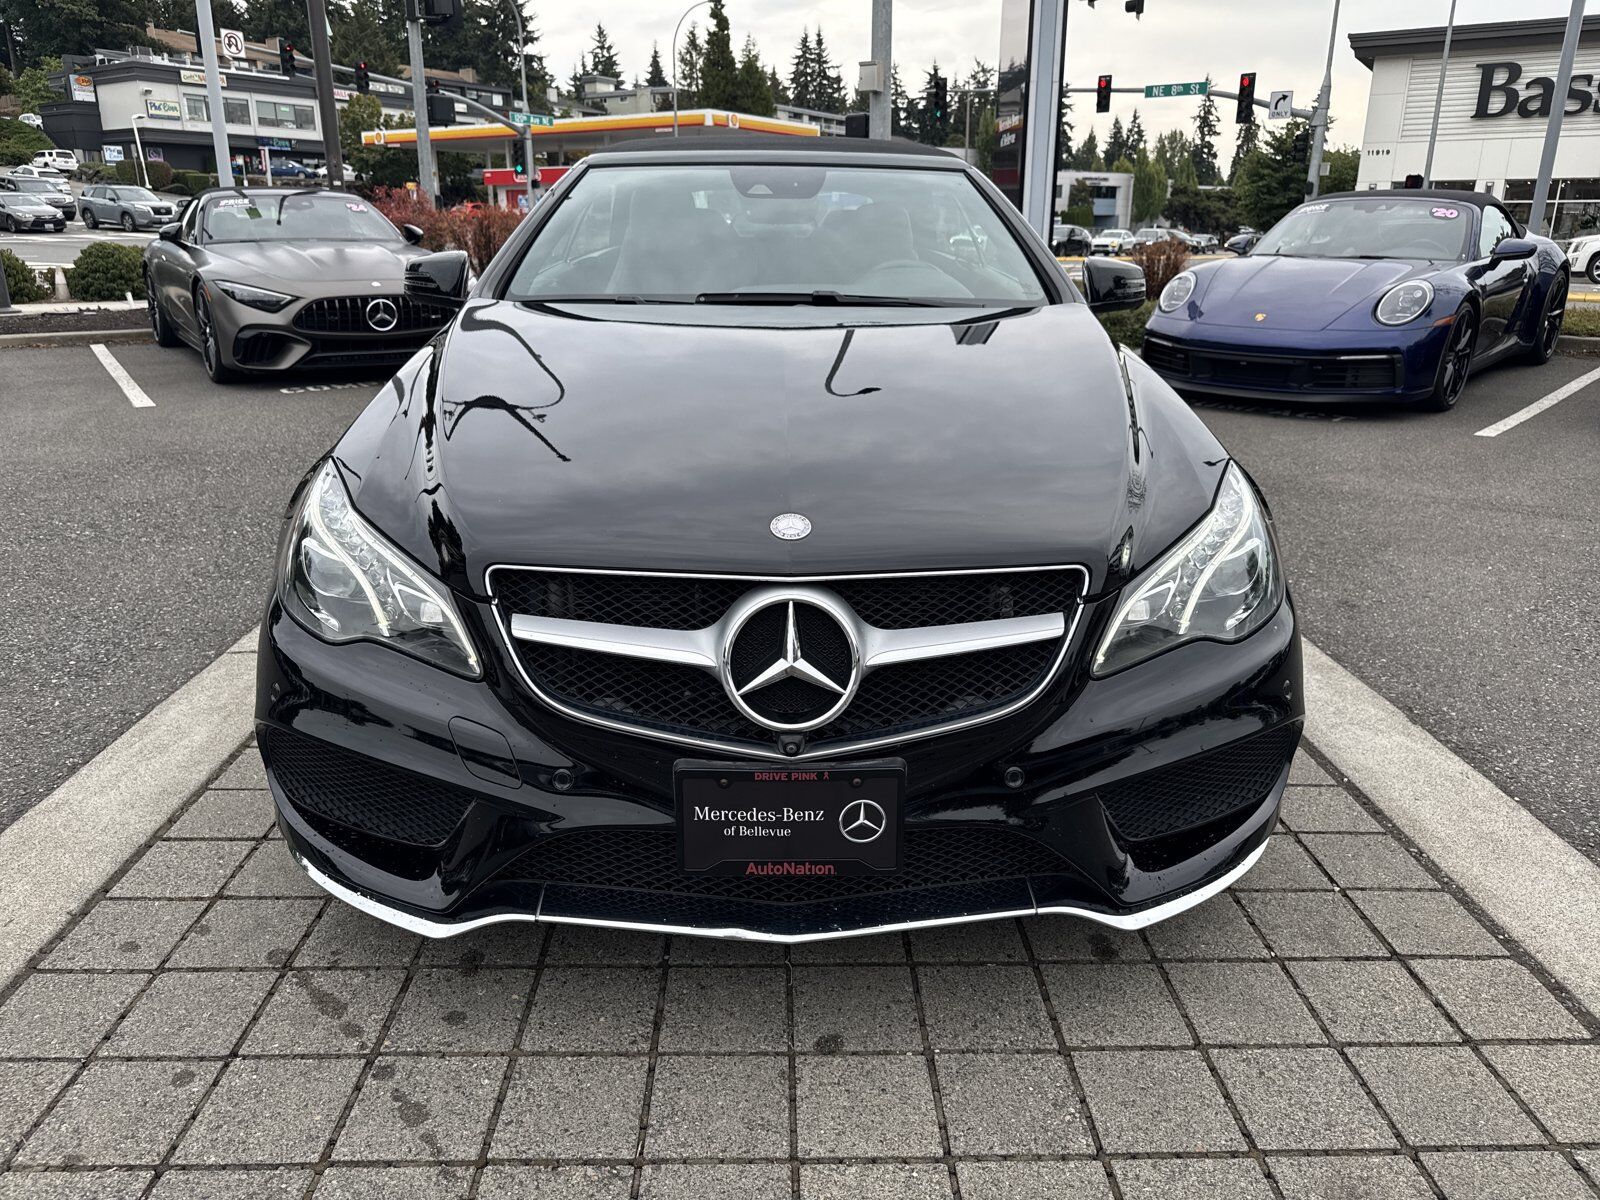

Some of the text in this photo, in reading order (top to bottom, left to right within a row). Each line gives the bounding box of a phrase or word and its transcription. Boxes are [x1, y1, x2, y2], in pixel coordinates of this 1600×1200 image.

[1152, 84, 1200, 96] NE 8th St
[514, 113, 550, 126] 120th Ave NE
[1271, 110, 1289, 118] ONLY
[1367, 149, 1391, 157] 11919
[754, 772, 818, 781] DRIVE PINK
[693, 806, 825, 822] Mercedes-Benz
[723, 826, 792, 837] of Bellevue
[745, 862, 835, 876] AutoNation
